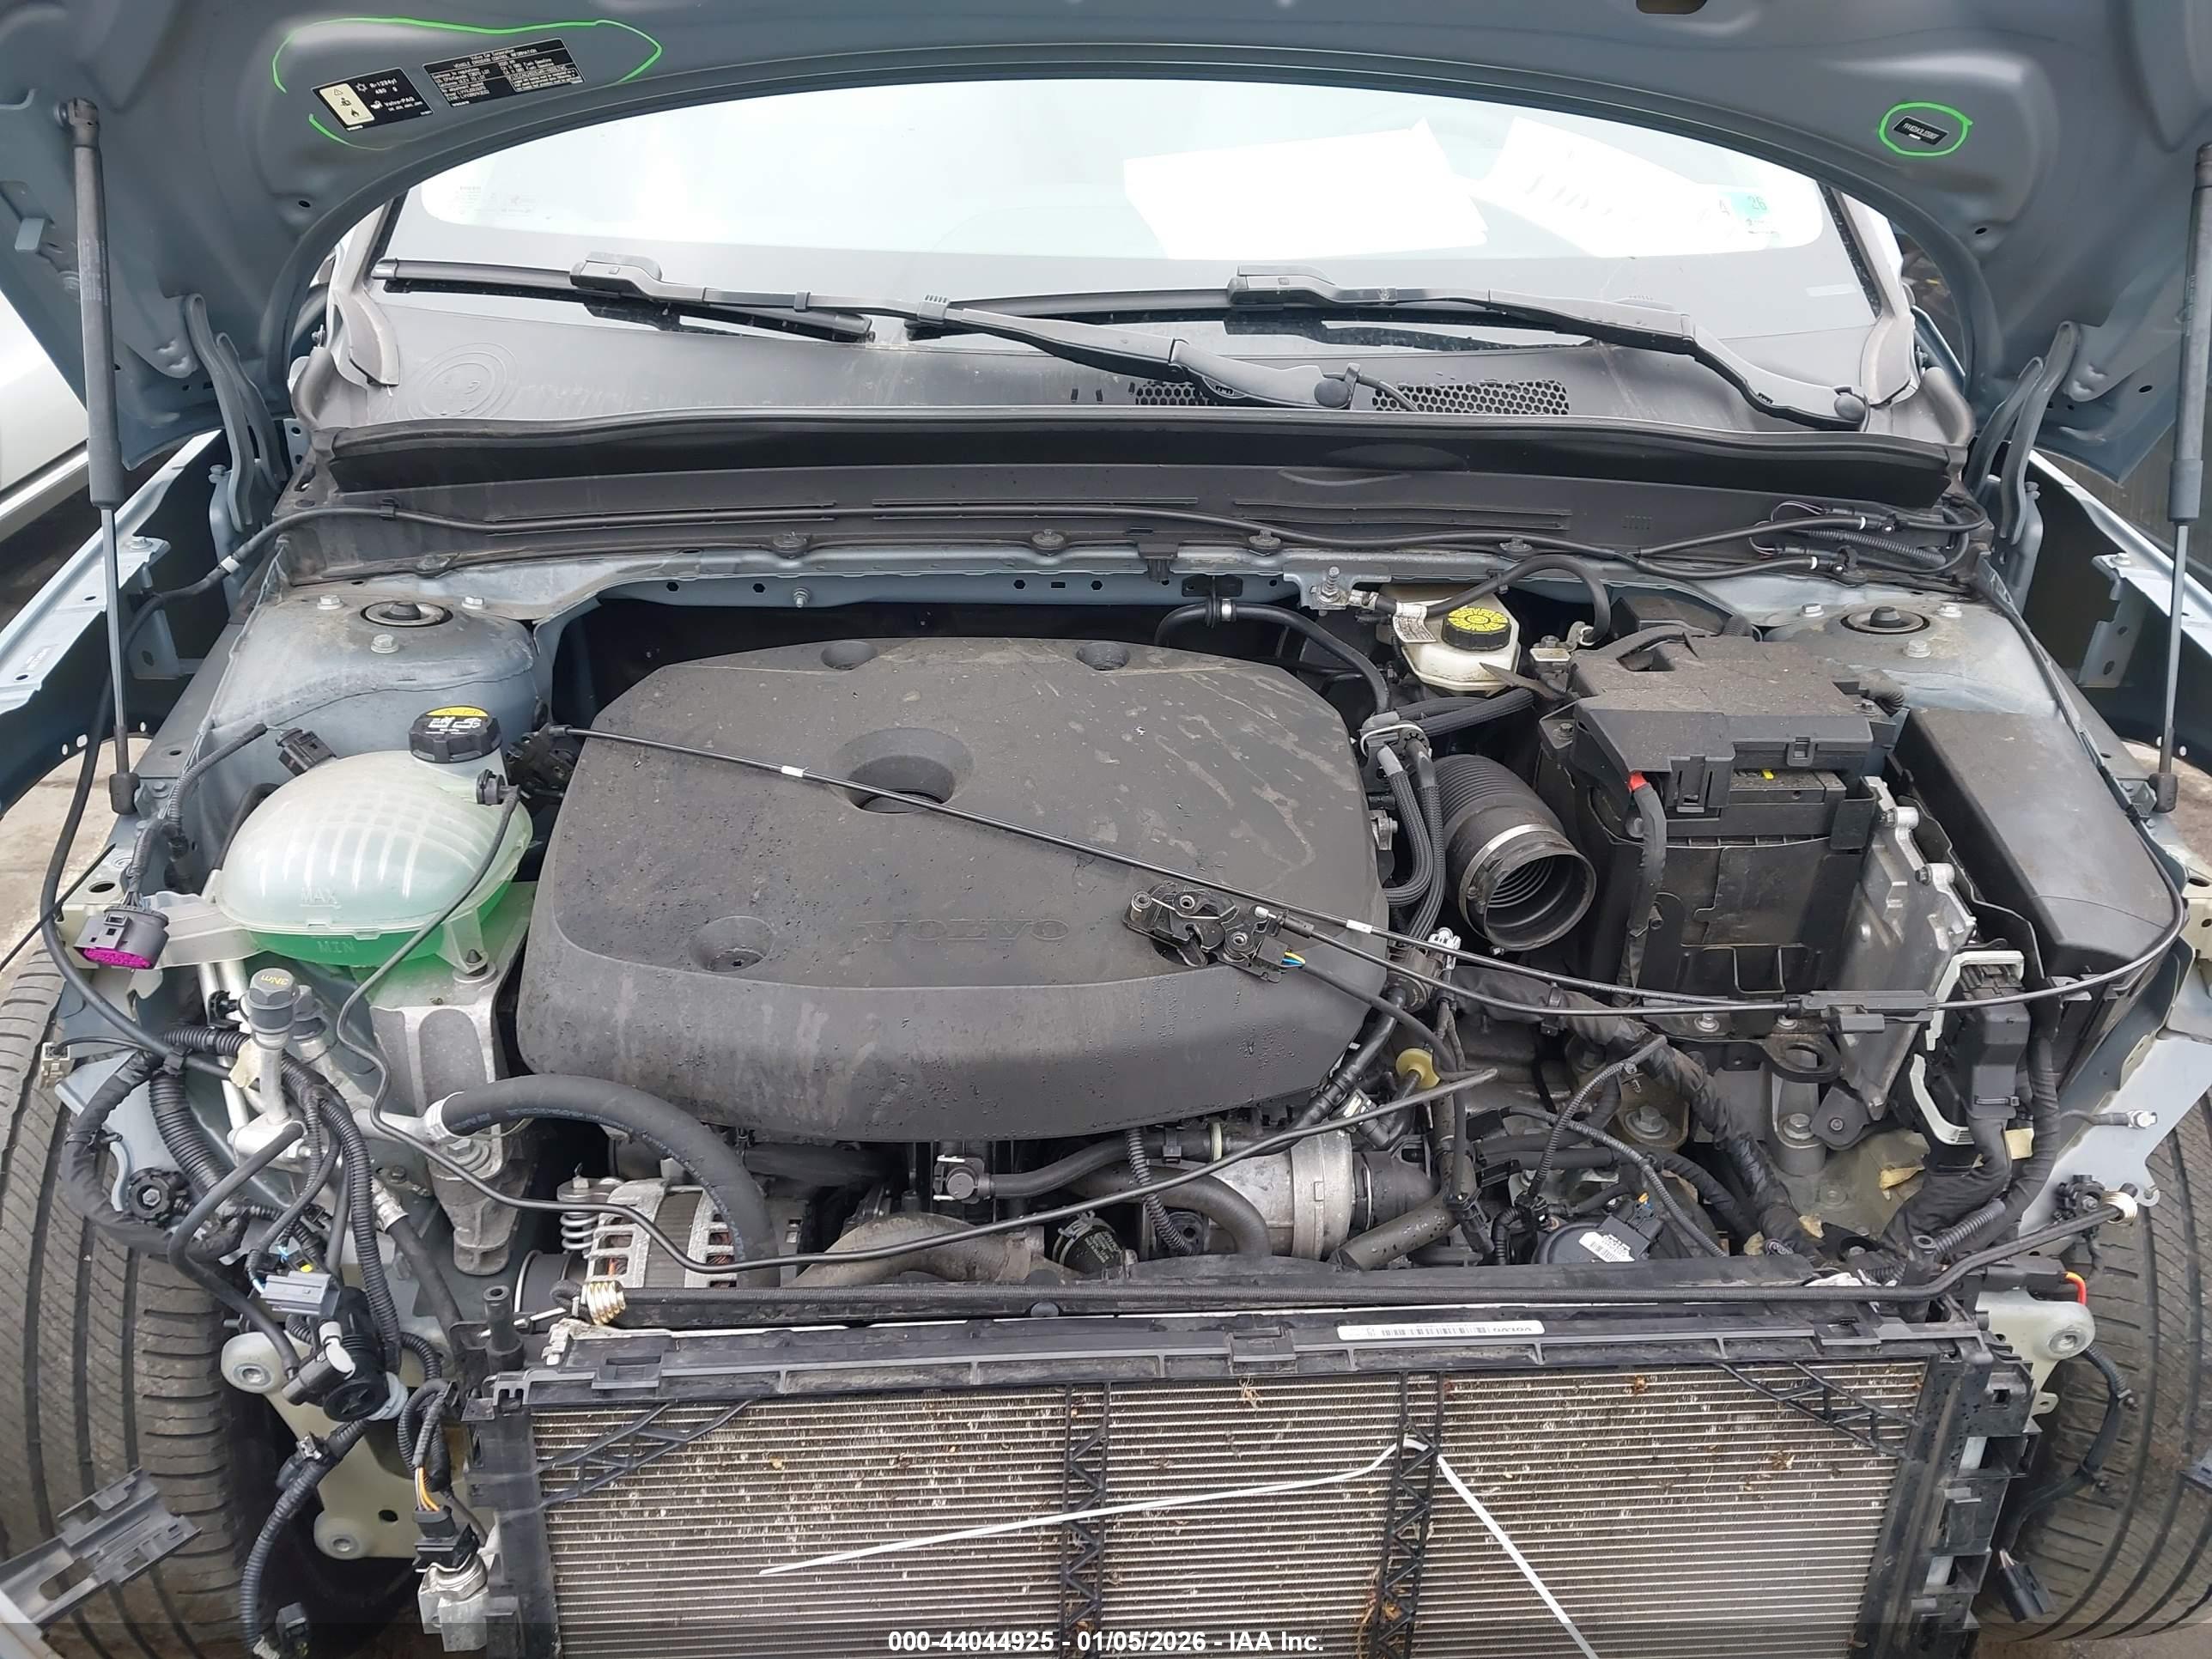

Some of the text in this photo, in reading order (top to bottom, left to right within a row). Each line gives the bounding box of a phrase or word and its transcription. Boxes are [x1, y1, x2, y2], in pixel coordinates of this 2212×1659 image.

[301, 885, 337, 903] MAX
[860, 919, 1070, 941] VOLVO
[317, 940, 356, 953] MIN
